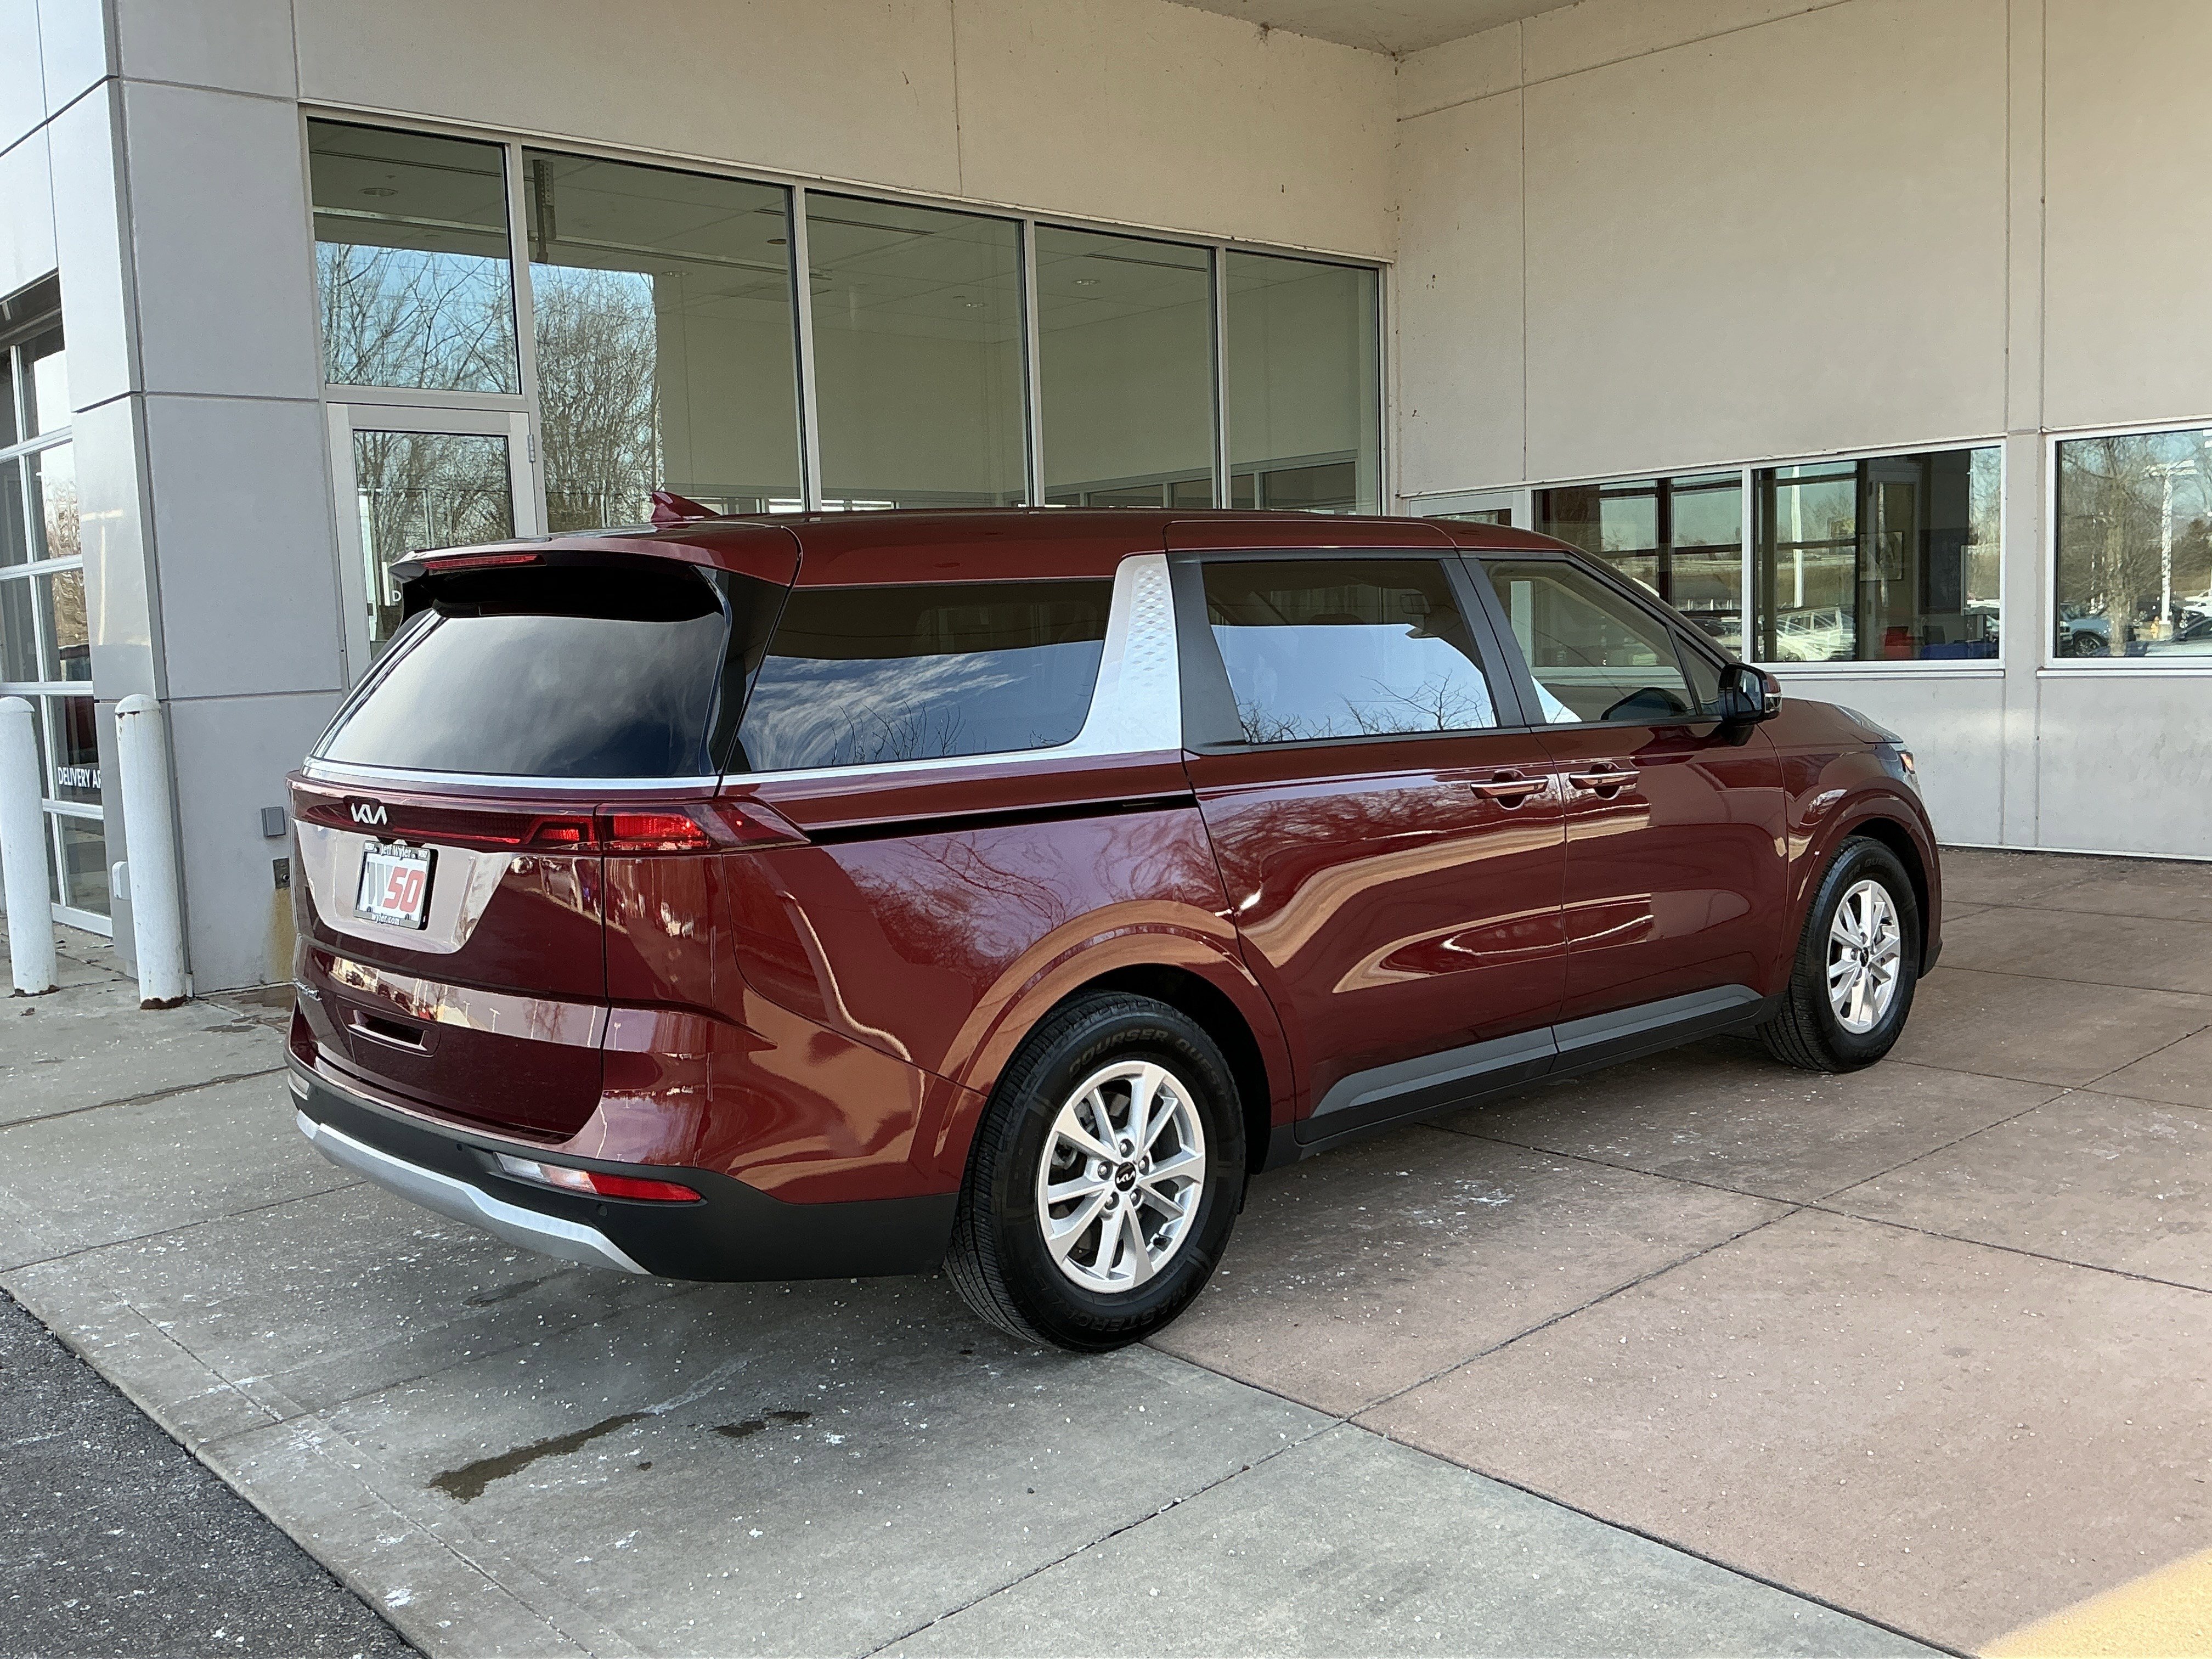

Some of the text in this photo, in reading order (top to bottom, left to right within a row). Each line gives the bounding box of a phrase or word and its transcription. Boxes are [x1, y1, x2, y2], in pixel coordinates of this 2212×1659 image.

[58, 766, 91, 788] DELIVERY
[351, 803, 387, 826] KIA
[381, 843, 393, 856] Jeff
[393, 844, 413, 861] Wyler
